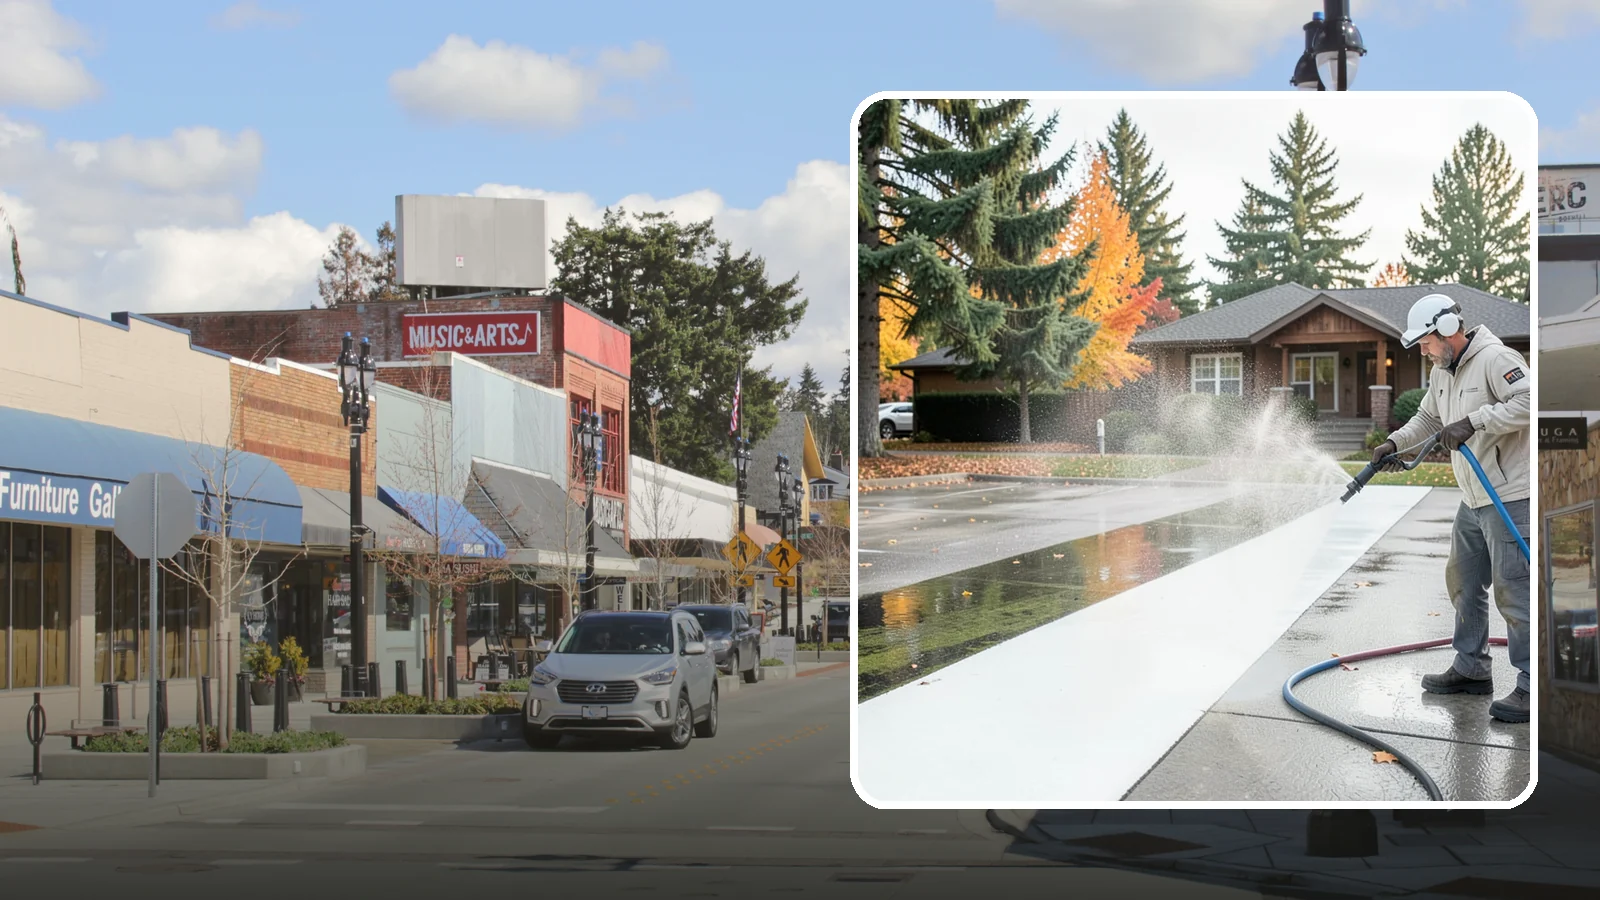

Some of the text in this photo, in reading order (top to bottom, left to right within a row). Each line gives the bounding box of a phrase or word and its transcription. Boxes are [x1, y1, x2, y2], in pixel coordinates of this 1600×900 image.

[0, 471, 121, 519] Furniture Gal
[453, 563, 479, 574] SUSHI
